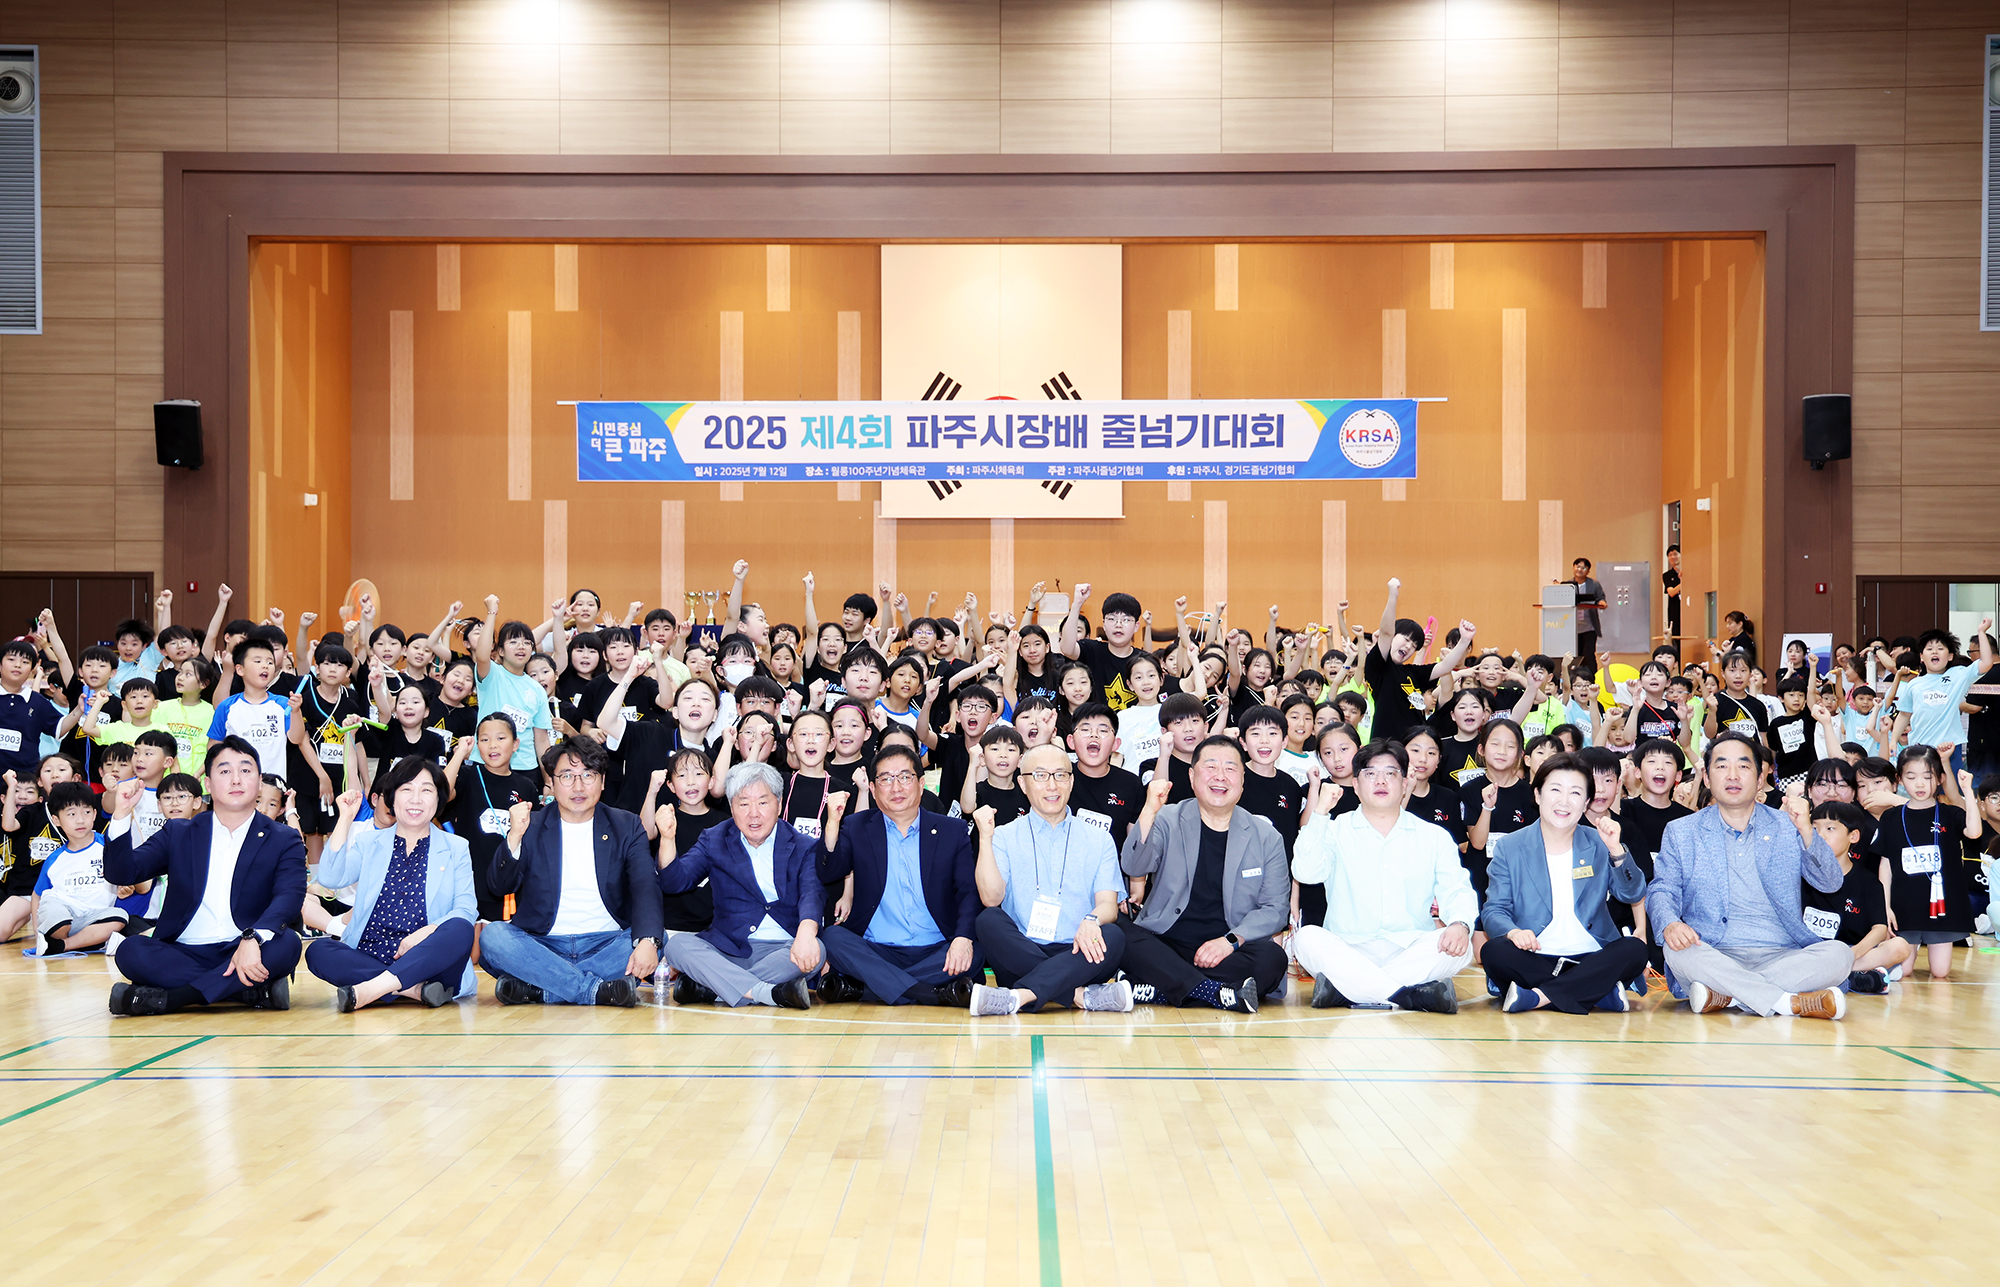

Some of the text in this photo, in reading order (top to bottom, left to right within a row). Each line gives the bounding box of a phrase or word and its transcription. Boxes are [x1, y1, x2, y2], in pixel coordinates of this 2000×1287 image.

[591, 420, 642, 437] 시민중심
[704, 413, 1285, 450] 2025 제4회 파주시장배 줄넘기대회
[1346, 429, 1394, 443] KRSA
[590, 437, 667, 462] 더 큰 파주
[694, 466, 713, 477] 일시
[720, 466, 751, 477] 2025년
[753, 466, 767, 477] 7월
[769, 466, 788, 477] 12일
[805, 466, 824, 477] 장소
[831, 466, 927, 477] 월롱100주년기념체육관
[971, 465, 1025, 476] 파주시체육회
[1047, 465, 1067, 476] 주관
[1073, 465, 1144, 476] 파주시줄넘기협회
[1167, 465, 1186, 476] 후원
[1192, 465, 1222, 476] 파주시,
[1224, 465, 1295, 476] 경기도줄넘기협회
[1736, 723, 1755, 732] 3530
[327, 748, 343, 757] 204
[1912, 851, 1941, 864] 1518
[73, 876, 97, 886] 1022
[1028, 924, 1055, 936] STAFF
